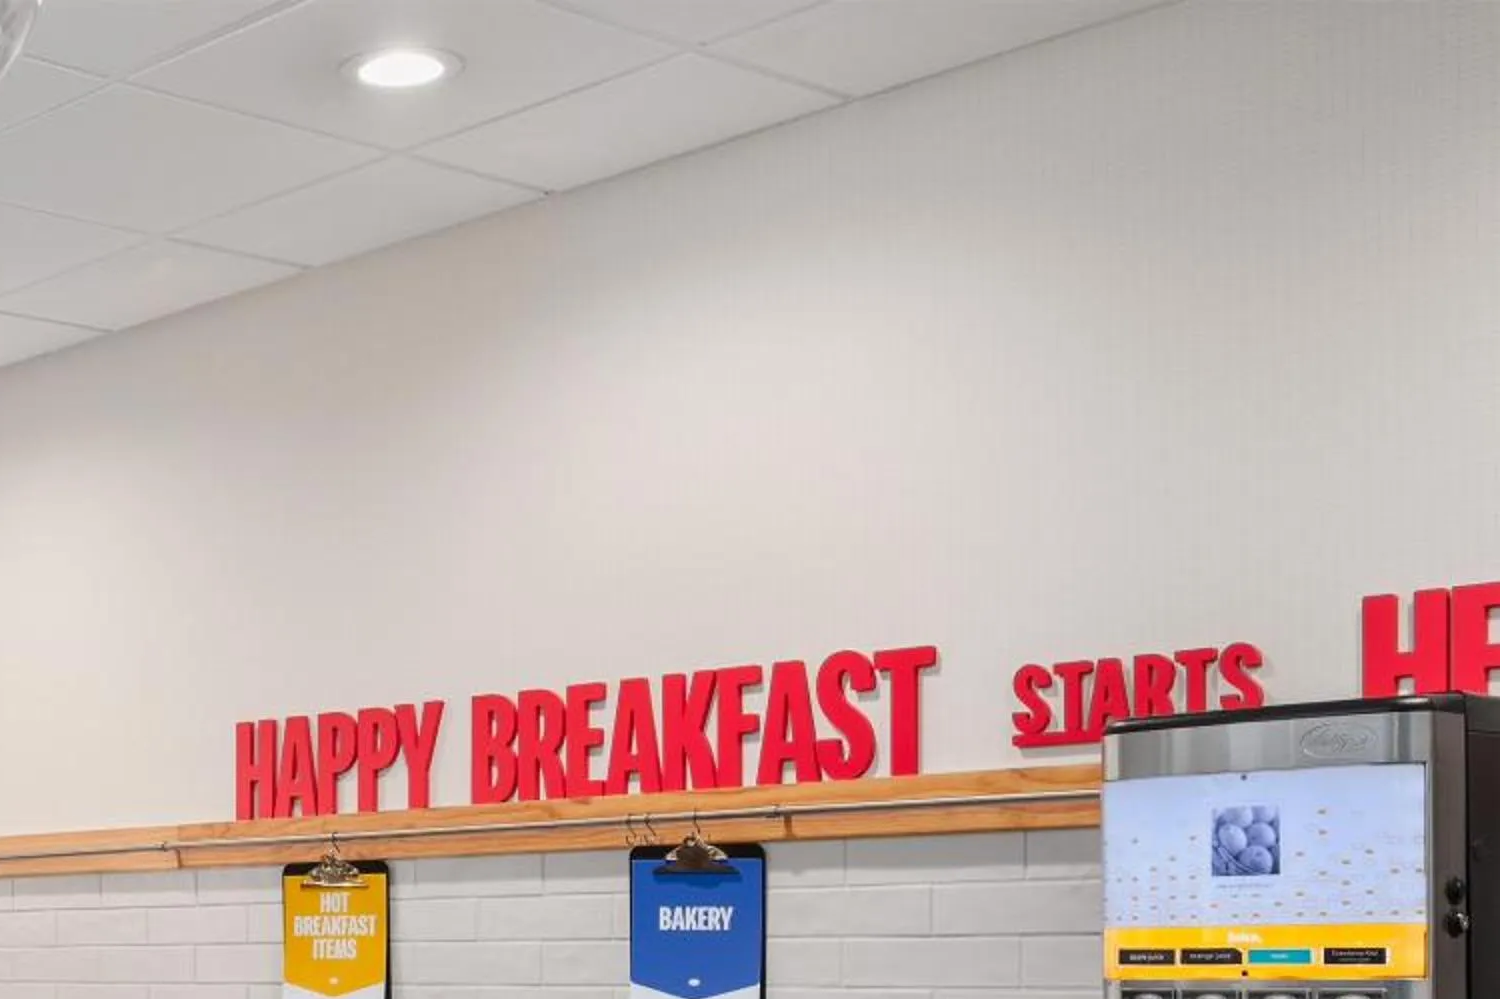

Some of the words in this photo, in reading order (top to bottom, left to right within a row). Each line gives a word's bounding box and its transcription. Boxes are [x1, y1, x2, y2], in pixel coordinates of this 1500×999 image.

[236, 701, 444, 820] HAPPY
[471, 646, 938, 805] BREAKFAST
[1012, 643, 1264, 740] STARTS
[320, 892, 351, 913] HOT
[293, 915, 377, 937] BREAKFAST
[659, 906, 733, 931] BAKERY
[312, 937, 357, 960] ITEMS
